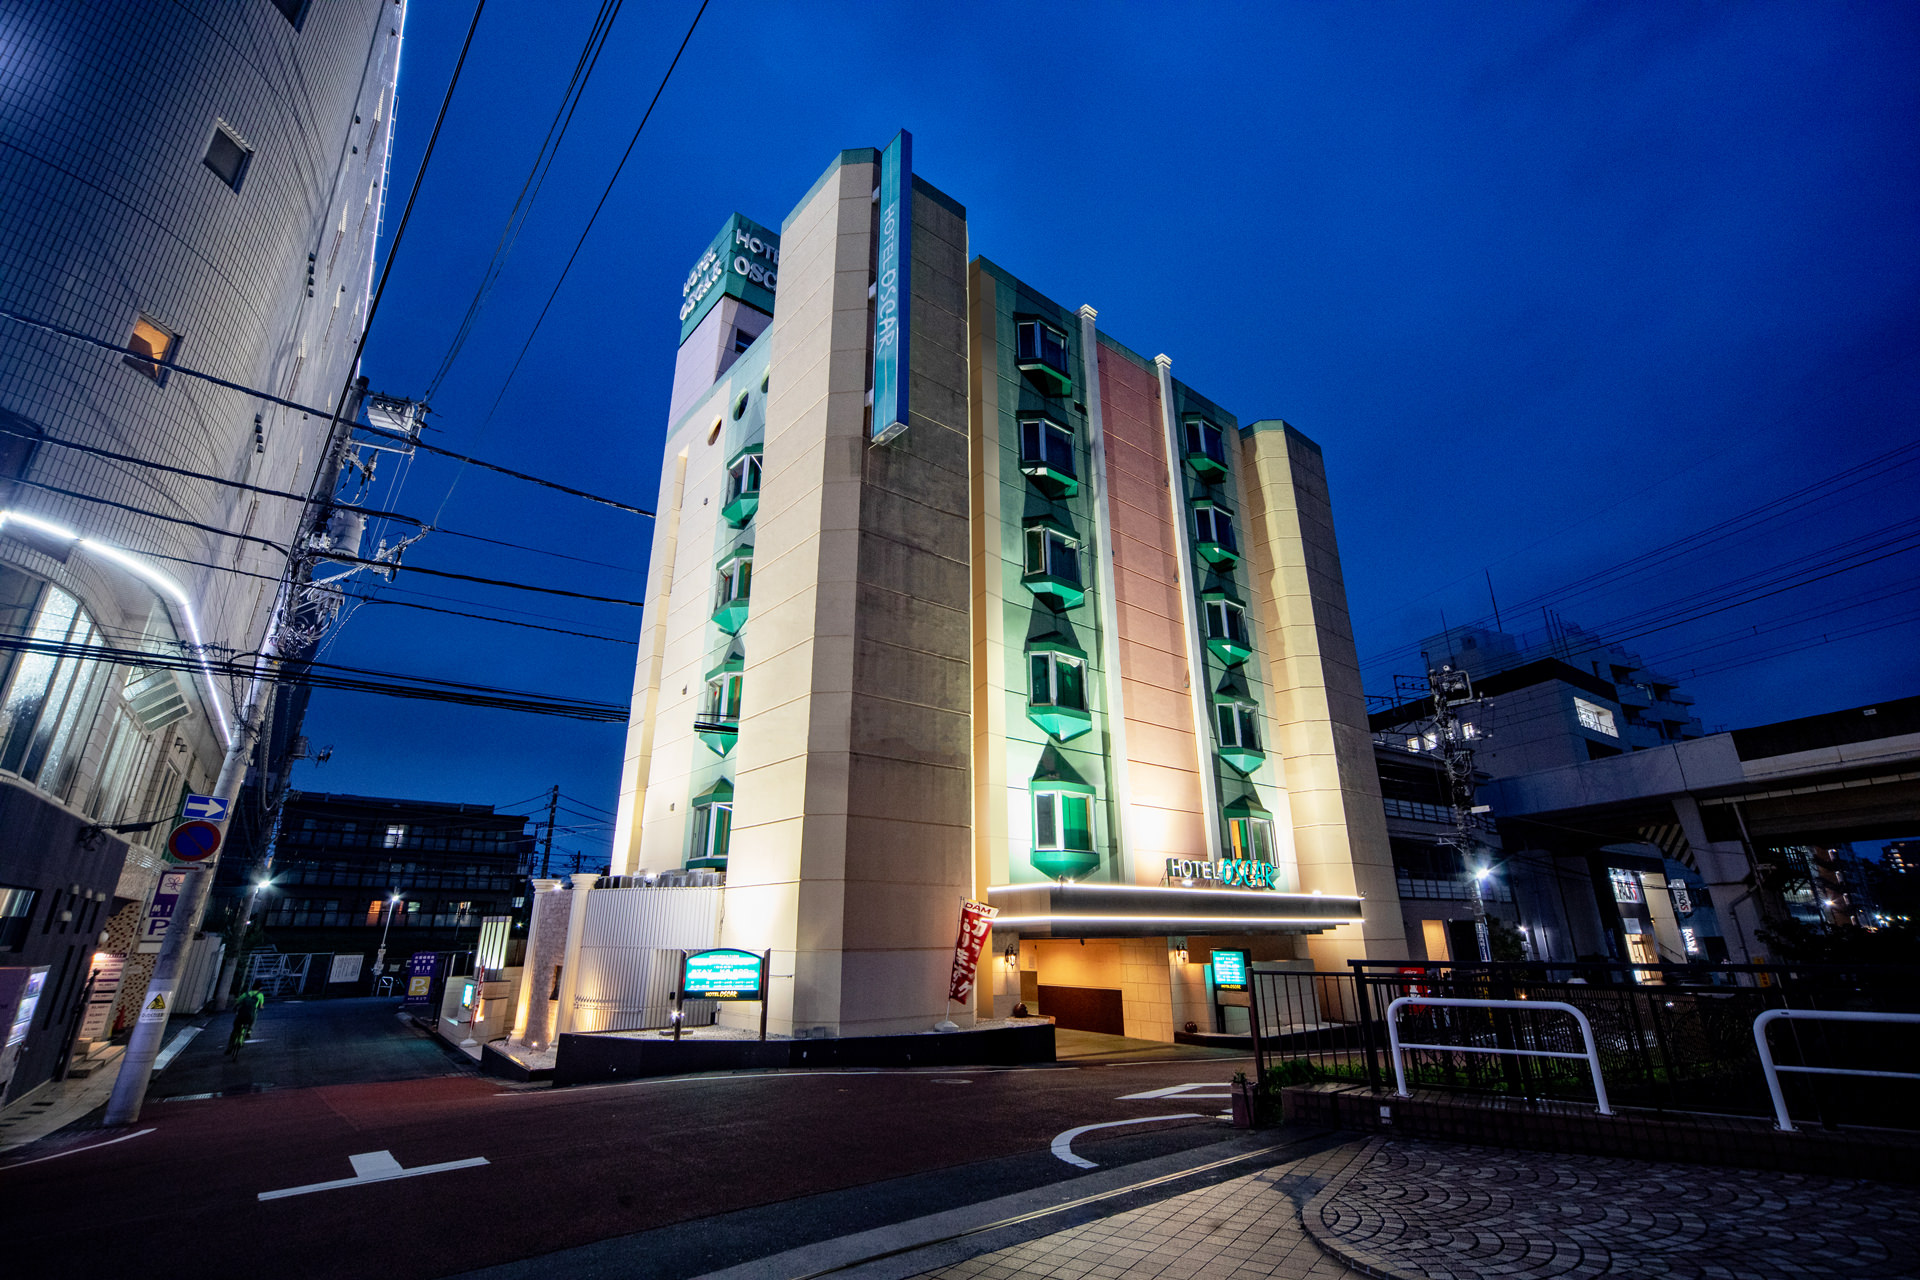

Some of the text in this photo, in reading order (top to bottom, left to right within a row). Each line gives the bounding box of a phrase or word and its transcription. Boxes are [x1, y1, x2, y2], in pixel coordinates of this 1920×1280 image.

[736, 229, 780, 265] HOTE
[682, 247, 717, 297] HOTEL
[734, 256, 777, 291] OSC
[877, 203, 897, 355] HOTEL OSCAR
[680, 260, 722, 321] OSCAR
[1172, 858, 1275, 890] HOTEL OSCAR
[152, 905, 171, 913] MI
[965, 902, 991, 915] DAM
[148, 919, 170, 935] P
[411, 979, 425, 992] P
